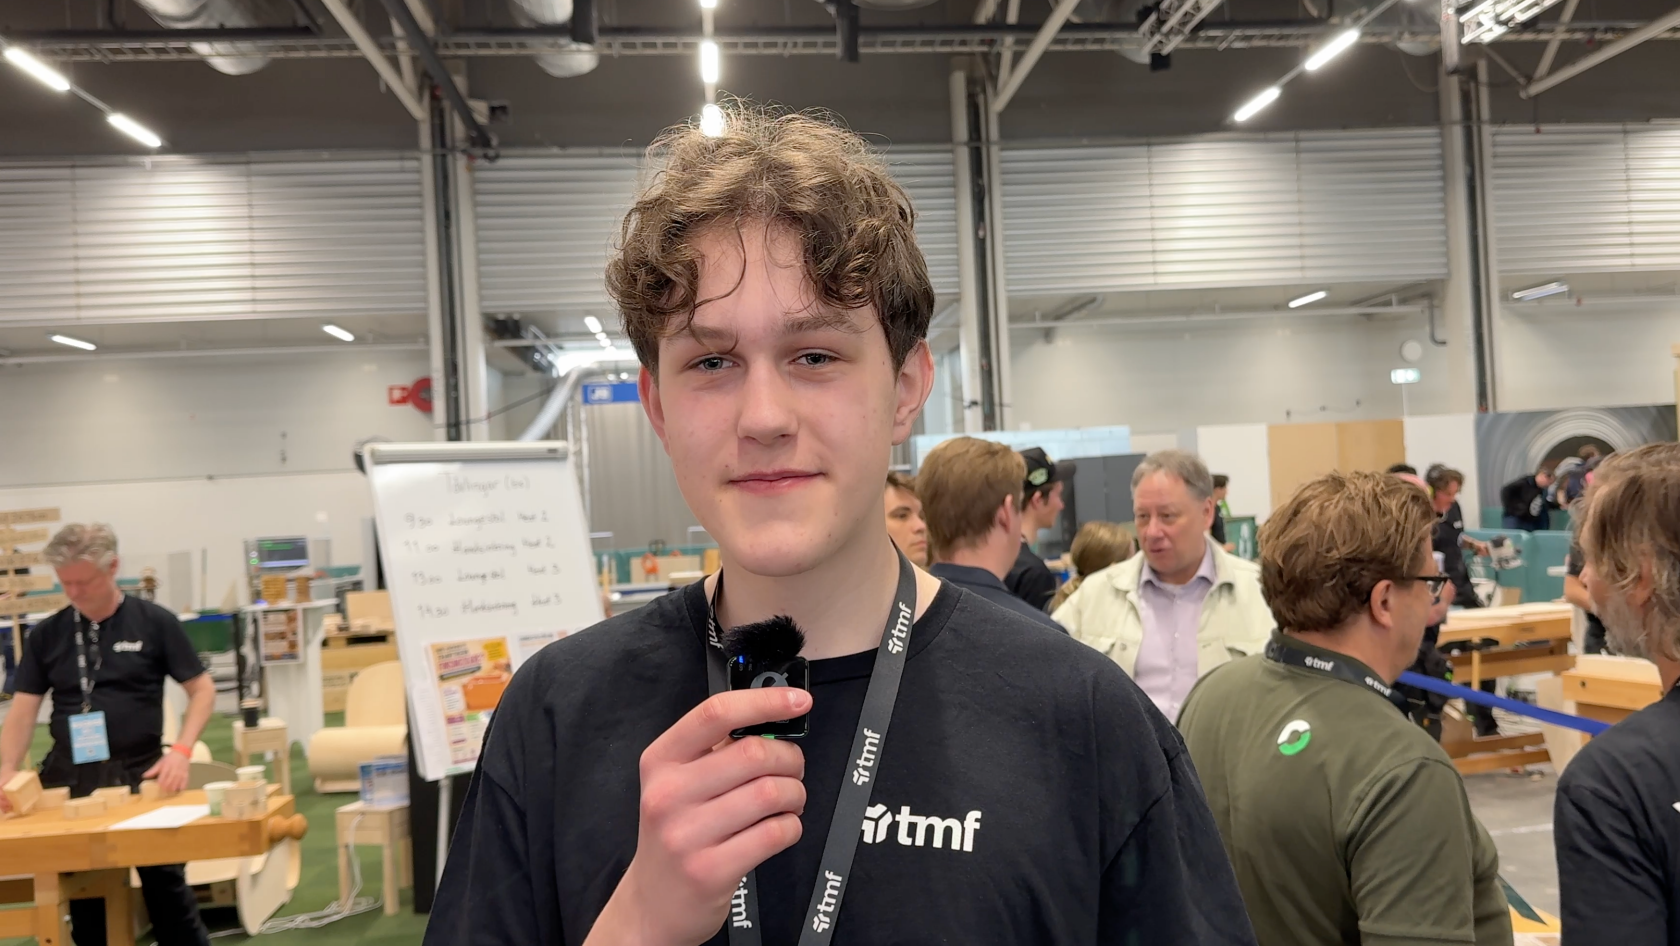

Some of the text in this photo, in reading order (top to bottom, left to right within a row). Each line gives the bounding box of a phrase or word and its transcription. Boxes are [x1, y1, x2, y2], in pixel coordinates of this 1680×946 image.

[891, 602, 912, 640] tmf
[1312, 657, 1334, 672] tmf
[858, 728, 881, 769] tmf
[895, 805, 982, 852] tmf
[816, 870, 843, 913] tmf
